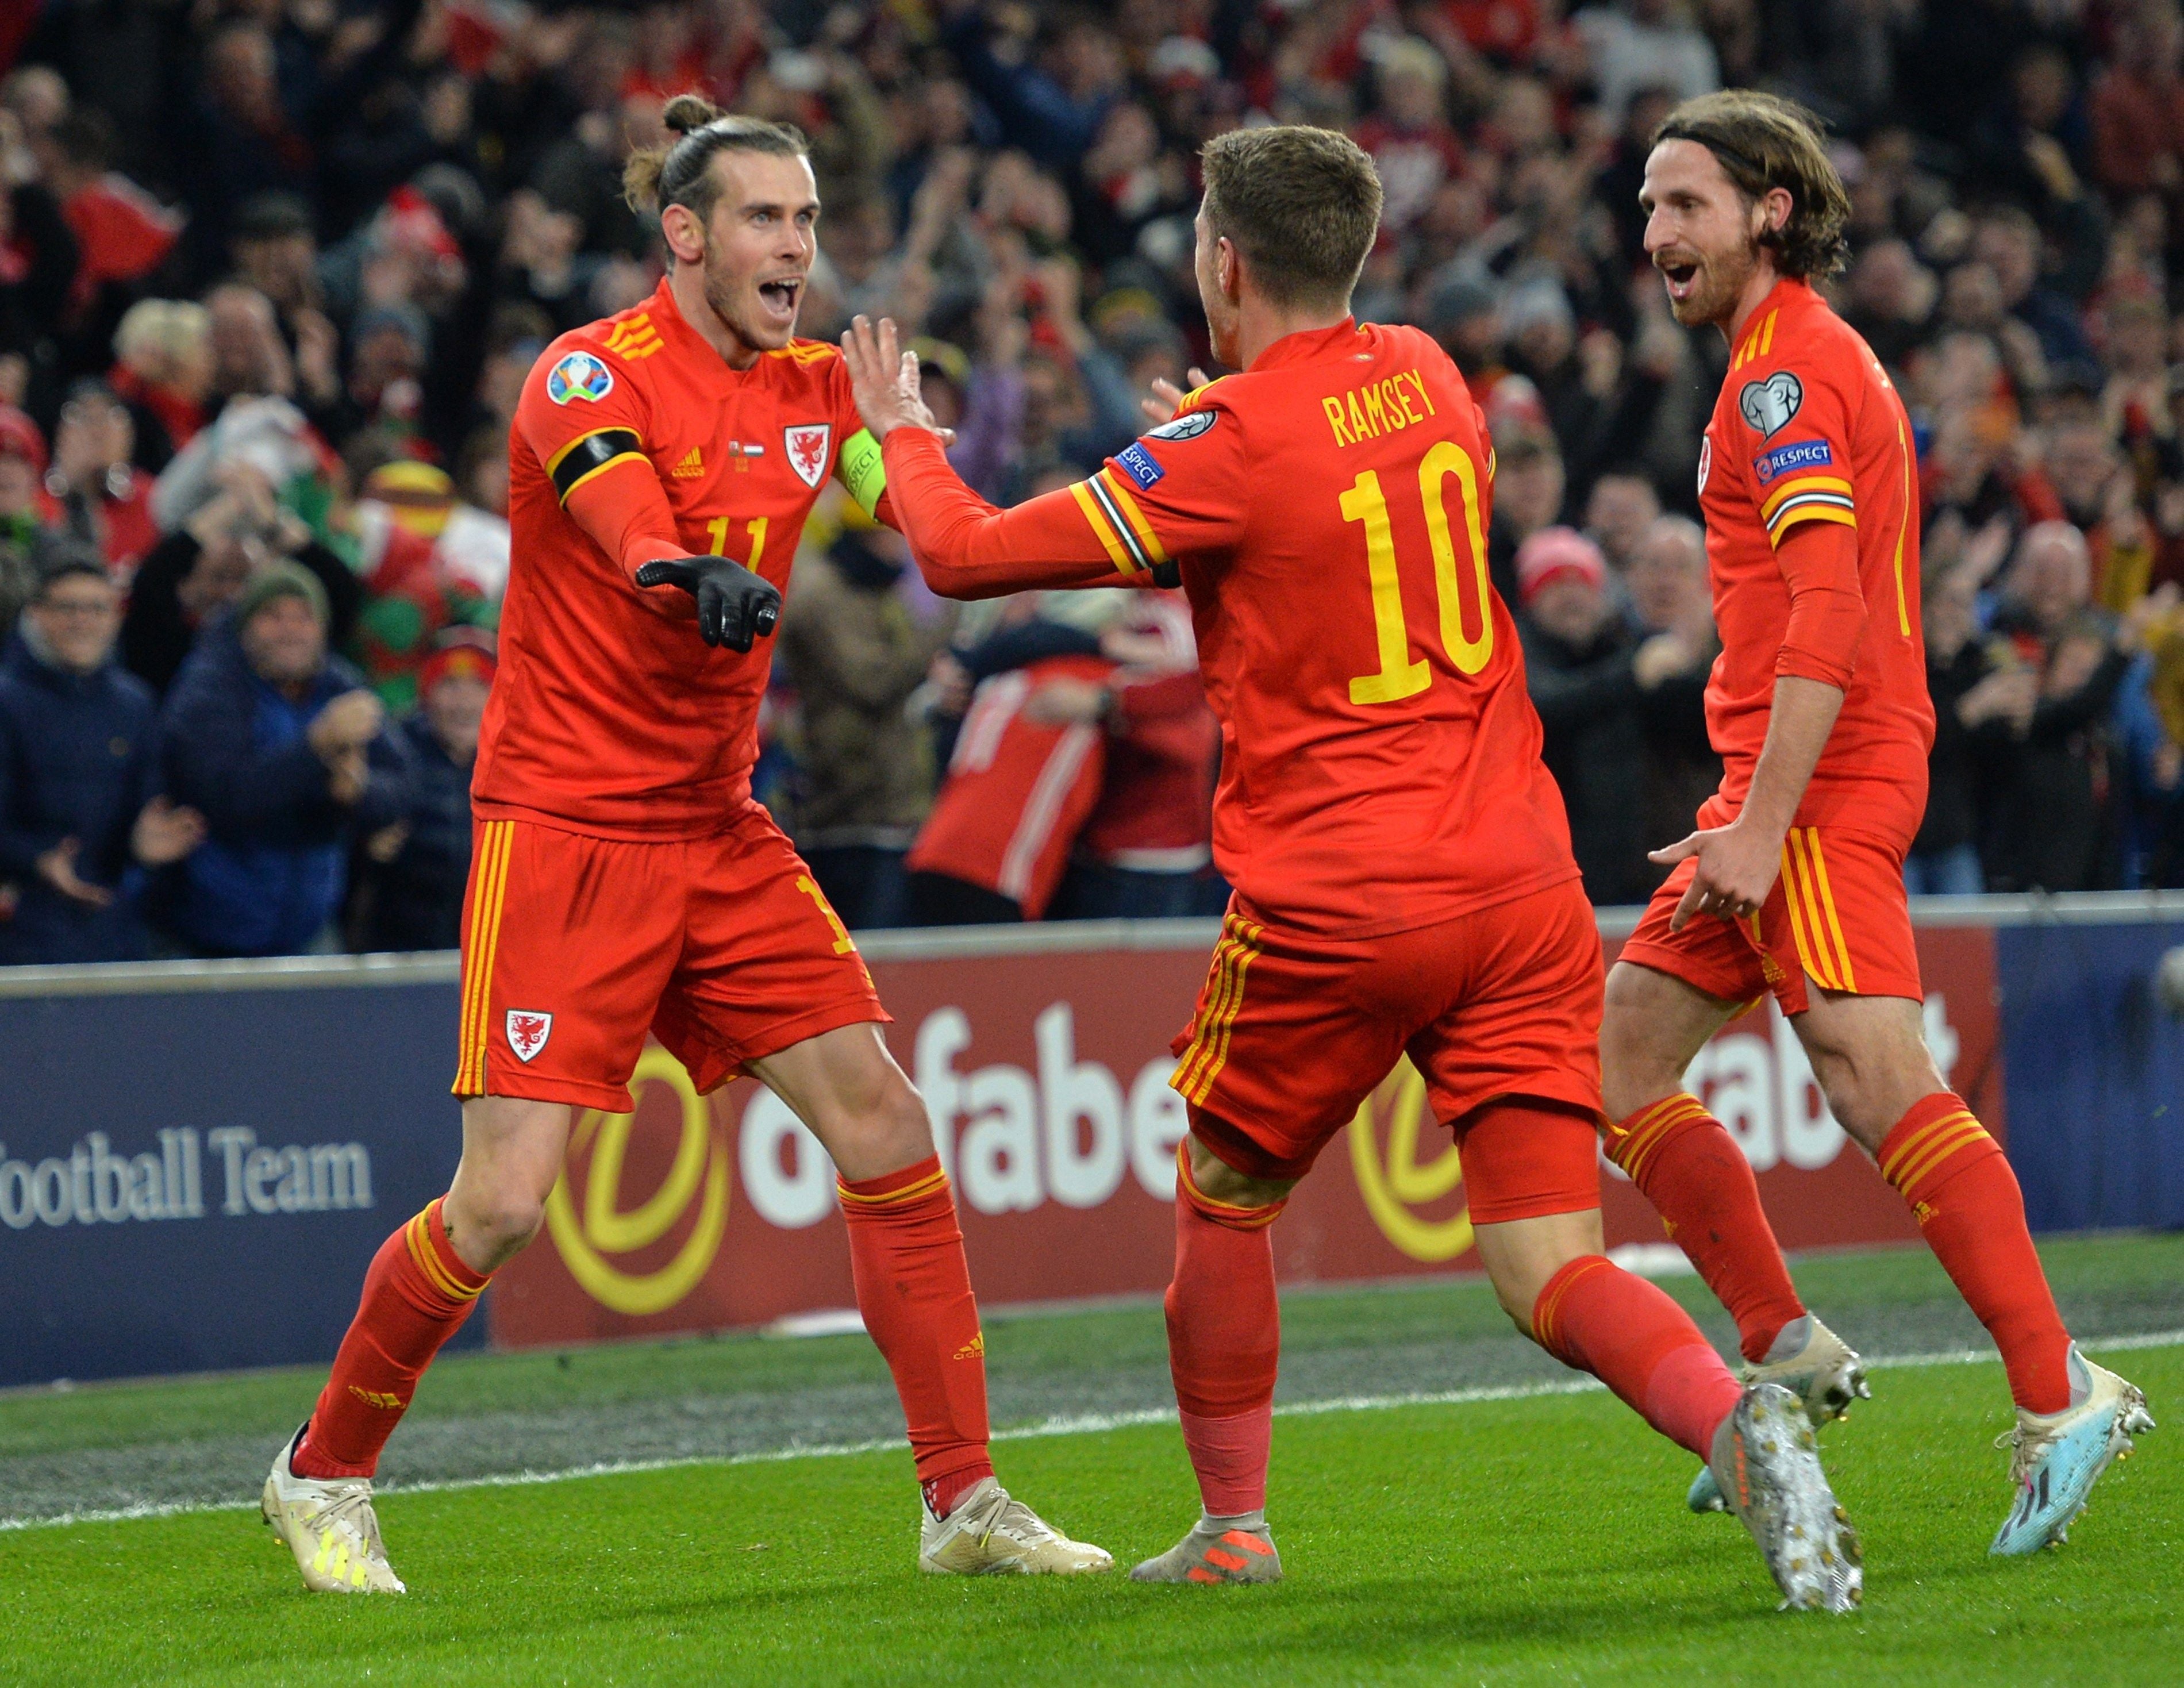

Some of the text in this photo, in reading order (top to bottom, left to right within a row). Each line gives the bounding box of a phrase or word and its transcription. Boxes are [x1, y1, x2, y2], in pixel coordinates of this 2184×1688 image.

[1322, 368, 1436, 448] RAMSEY
[1122, 447, 1159, 483] ESPECT
[1772, 445, 1829, 470] RESPECT
[706, 516, 768, 574] 11
[1338, 441, 1493, 706] 10
[0, 1124, 377, 1229] ootball Team
